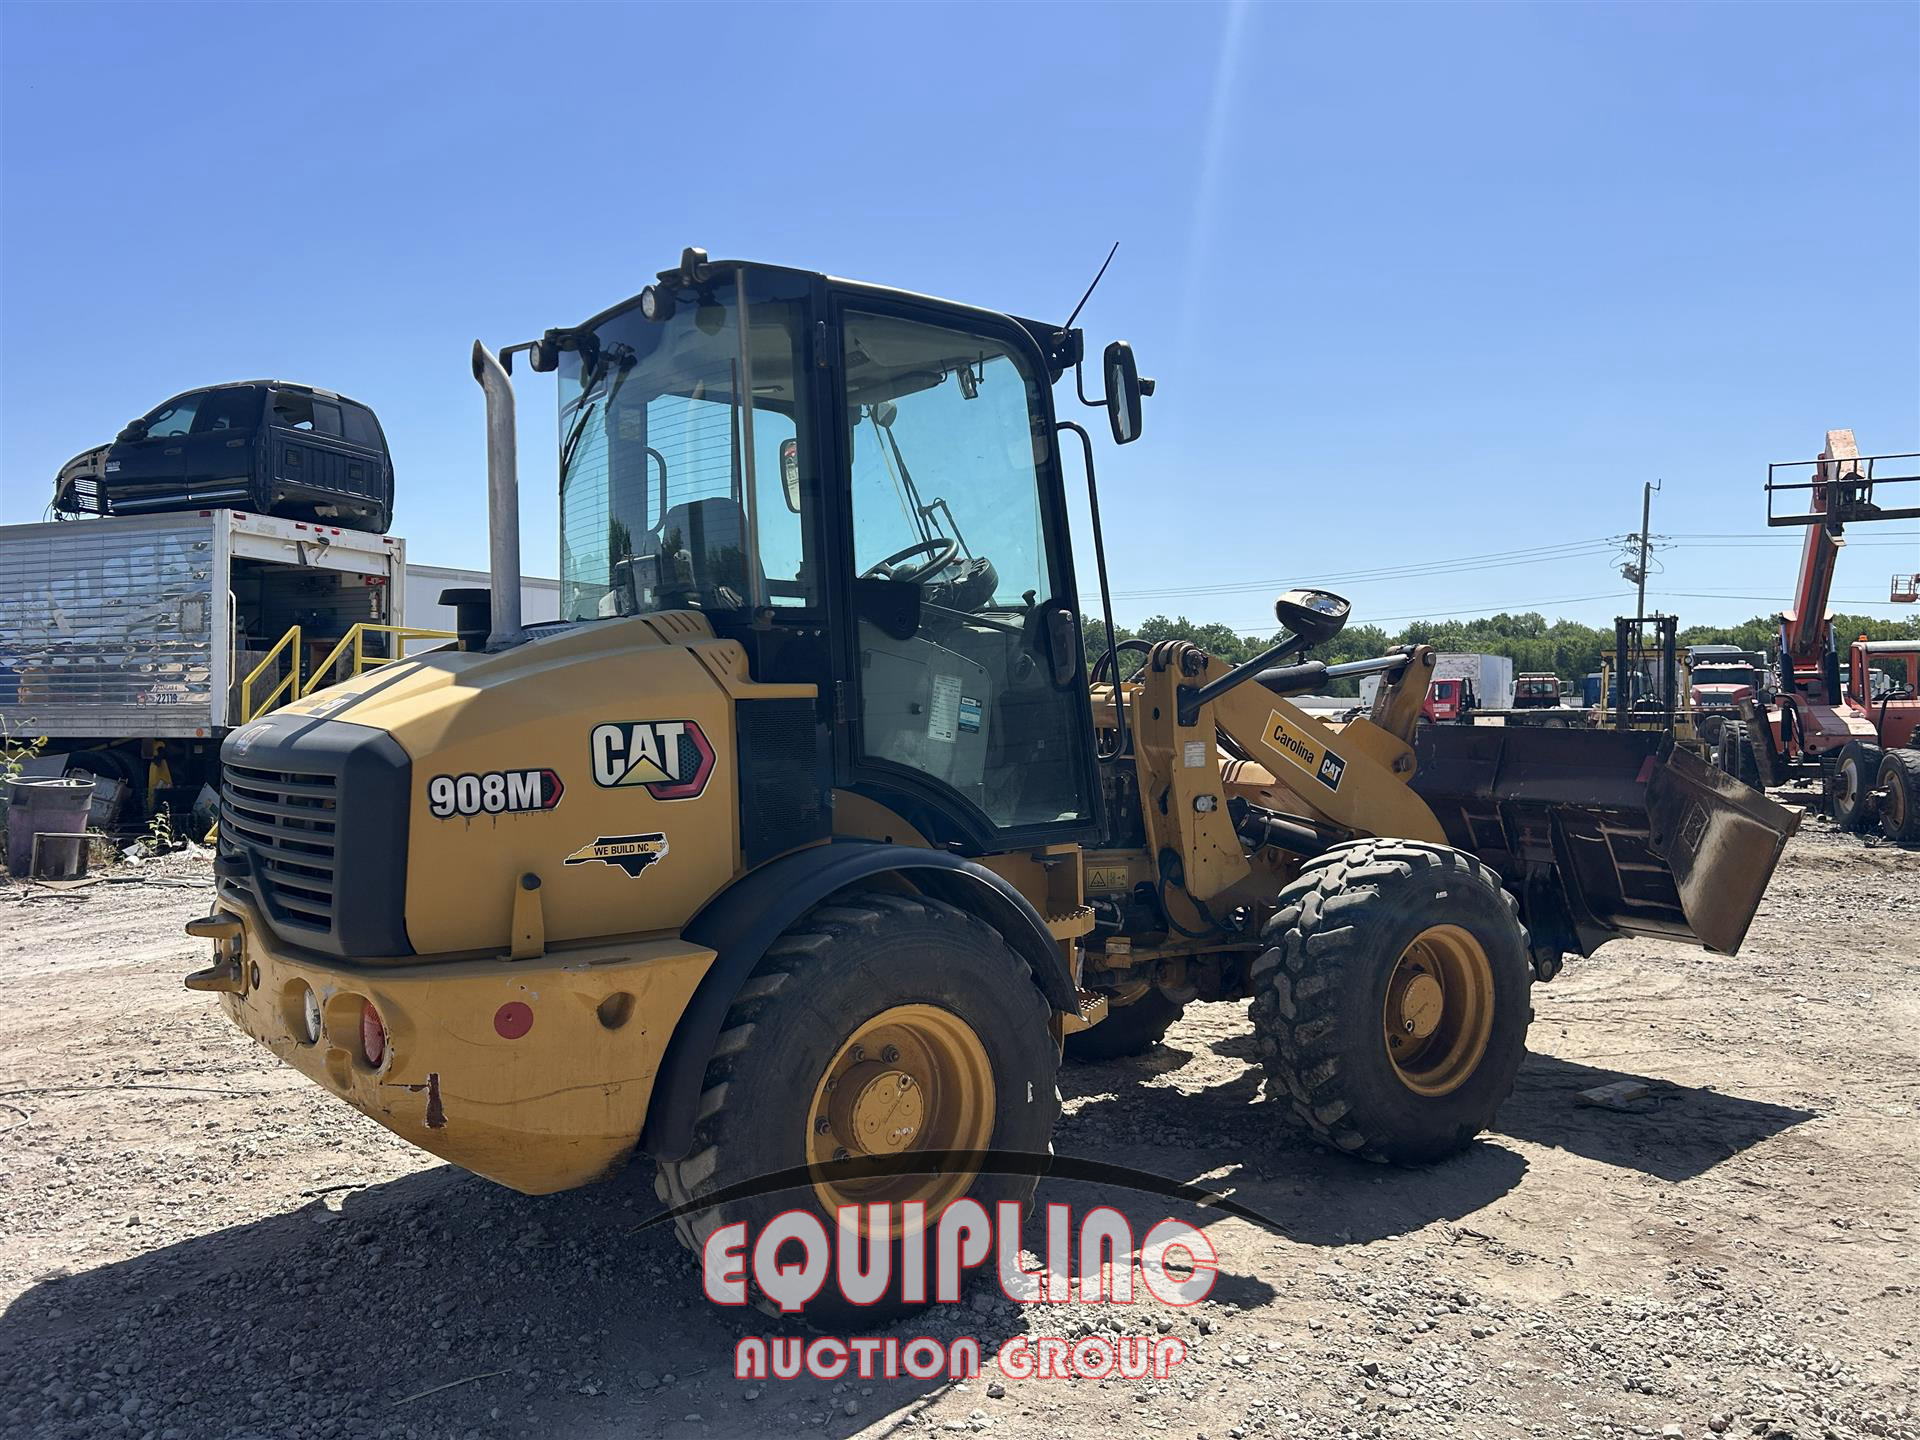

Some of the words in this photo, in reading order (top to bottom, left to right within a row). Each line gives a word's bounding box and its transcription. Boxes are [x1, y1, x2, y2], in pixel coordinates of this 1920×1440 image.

[592, 723, 685, 785] CAT
[1274, 725, 1314, 764] Carolina
[1322, 759, 1341, 781] CAT
[430, 772, 541, 815] 908M
[594, 846, 609, 856] WE
[611, 844, 635, 855] BUILD
[637, 843, 649, 852] NC
